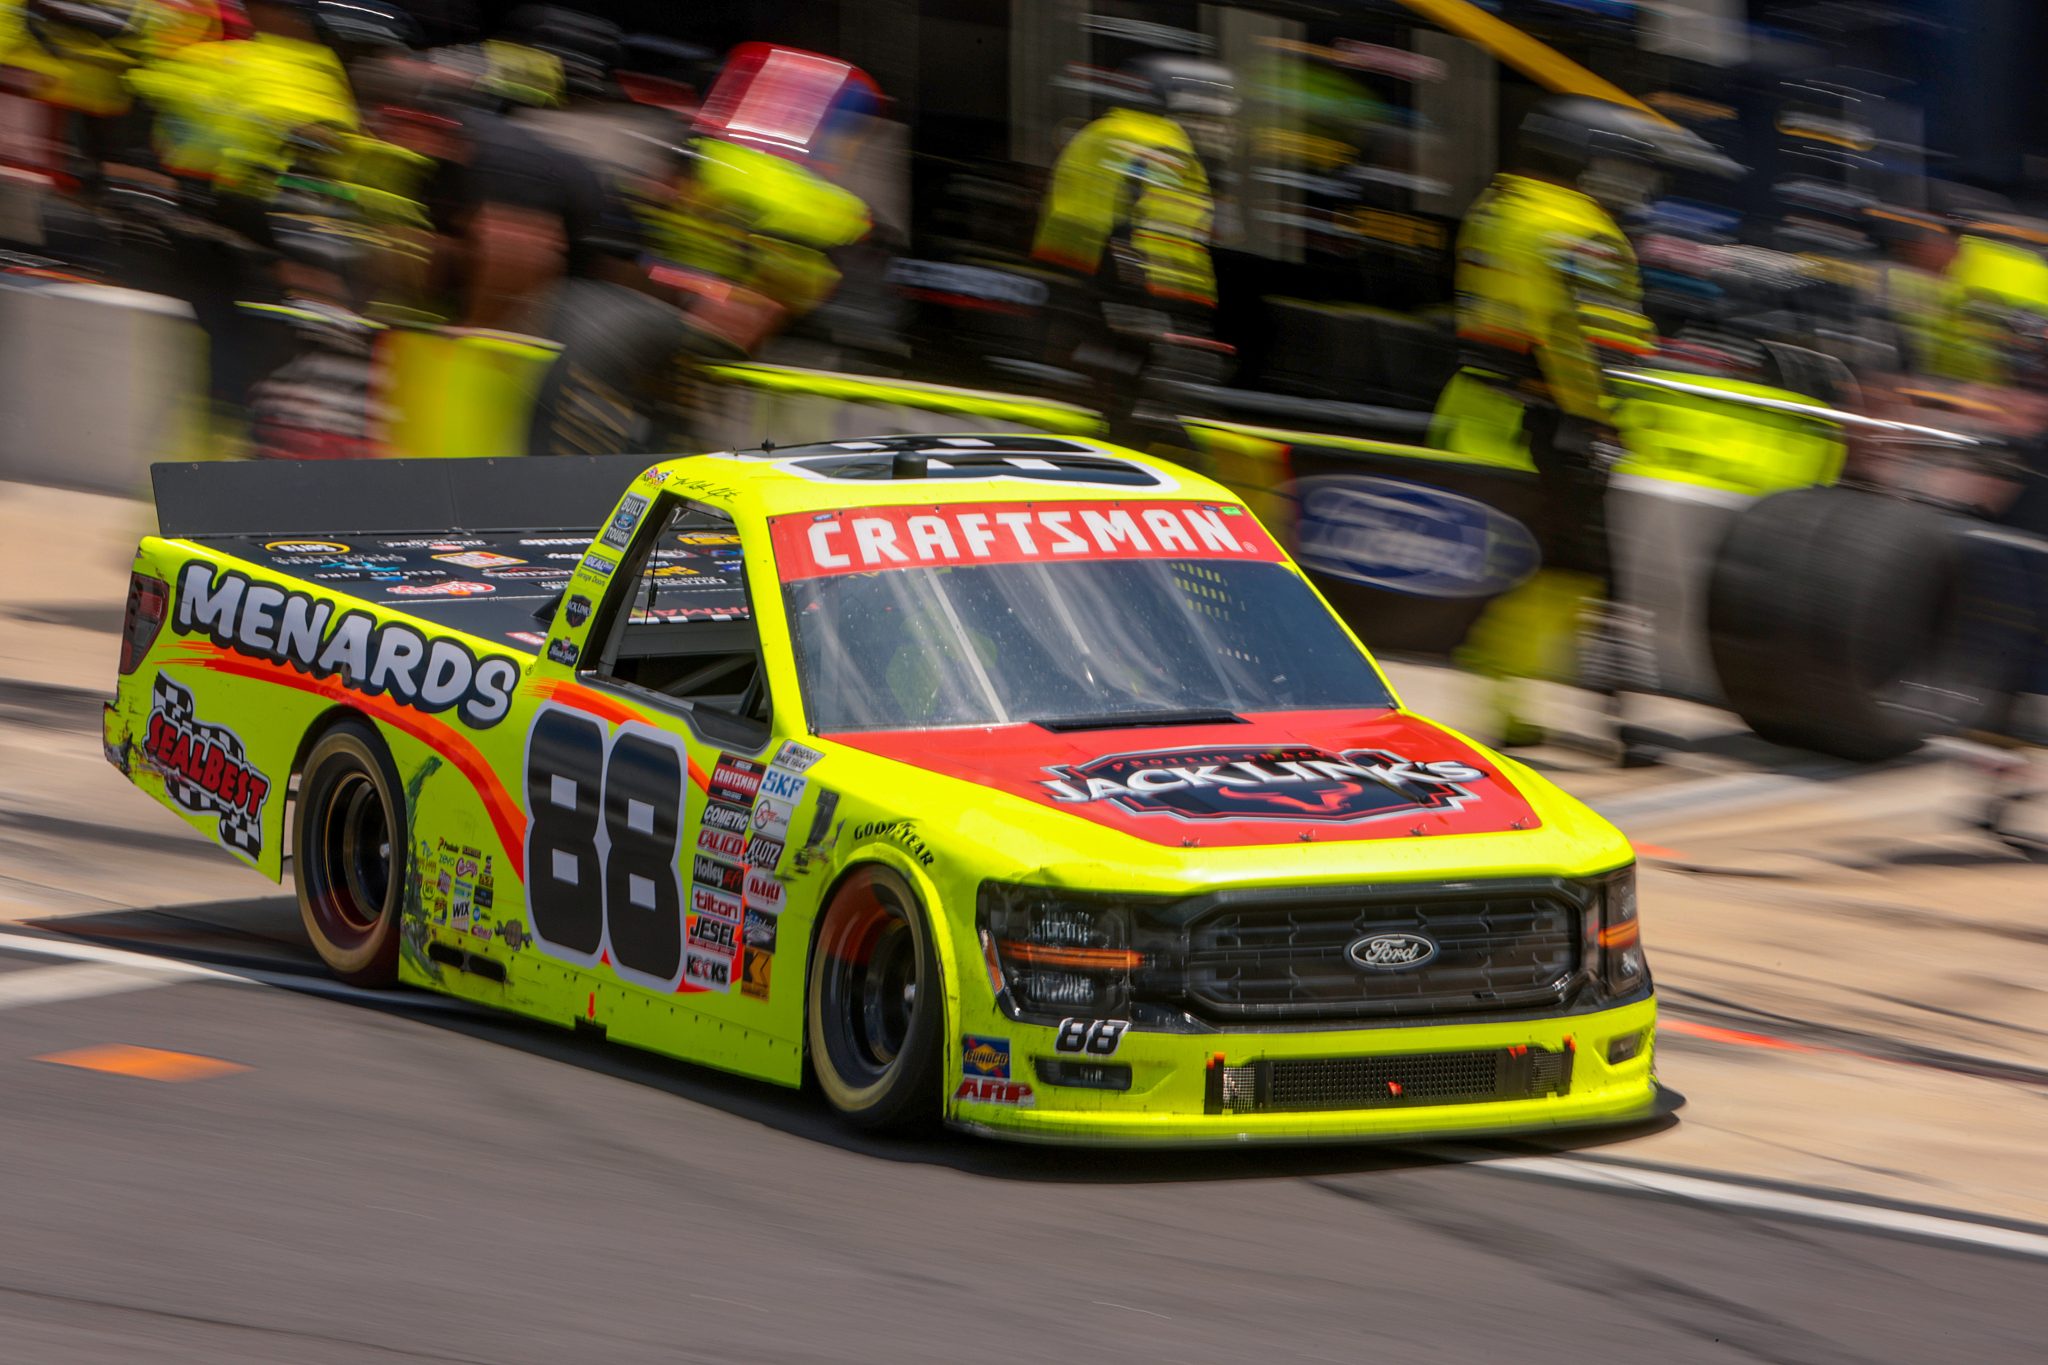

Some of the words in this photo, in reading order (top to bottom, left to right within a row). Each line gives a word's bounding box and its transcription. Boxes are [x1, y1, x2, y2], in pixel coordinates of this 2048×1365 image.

[620, 497, 646, 517] BUILT
[606, 527, 630, 544] TOUGH
[807, 510, 1245, 568] CRAFTSMAN
[177, 562, 518, 724] MENARDS
[146, 714, 269, 817] SEALBEST
[1112, 754, 1230, 772] PROTEIN
[714, 768, 760, 792] CRAFTSMAN
[762, 769, 805, 799] SKF
[703, 804, 750, 830] COMETIC
[524, 702, 687, 989] 88
[698, 828, 743, 856] CALICO
[749, 837, 782, 865] KLOTZ
[853, 820, 935, 867] GOODYEAR
[694, 855, 724, 887] Holley
[452, 901, 470, 919] WIX
[694, 890, 739, 920] tilton
[689, 916, 738, 949] JESEL
[1365, 938, 1420, 962] Ford
[1054, 1018, 1133, 1057] 88
[963, 1050, 1009, 1068] SUNOCO
[953, 1077, 1034, 1105] ARP
